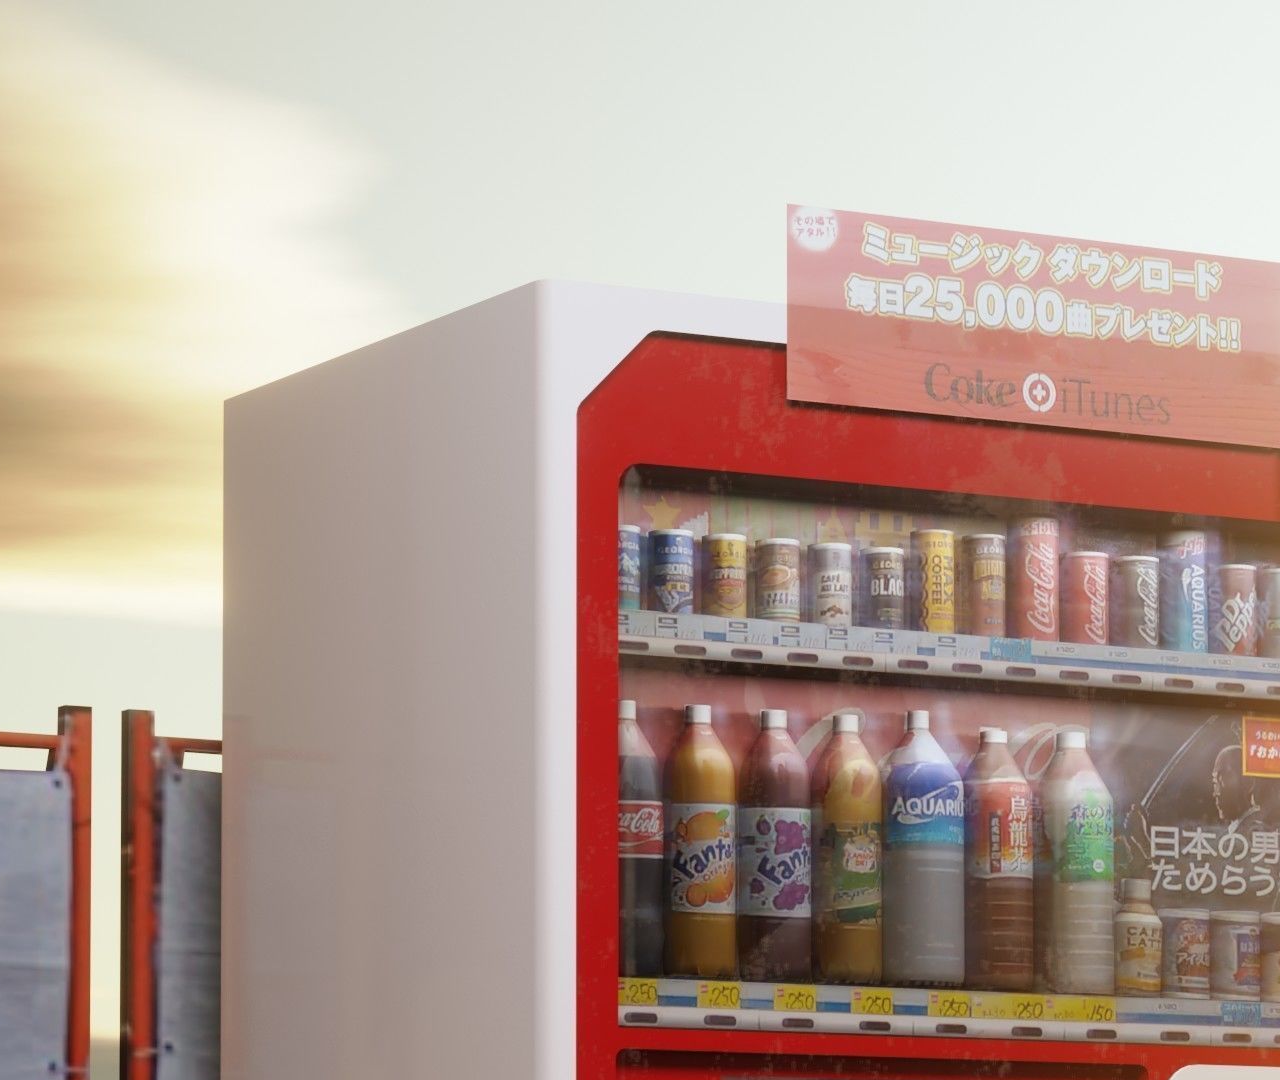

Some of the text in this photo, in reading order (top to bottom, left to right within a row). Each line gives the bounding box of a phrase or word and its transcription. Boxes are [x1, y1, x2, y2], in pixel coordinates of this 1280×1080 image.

[861, 222, 1223, 303] ミュージック ダウンロード
[845, 272, 1242, 354] 毎日25,000曲プレゼント!!
[924, 362, 1172, 426] Coke iTunes
